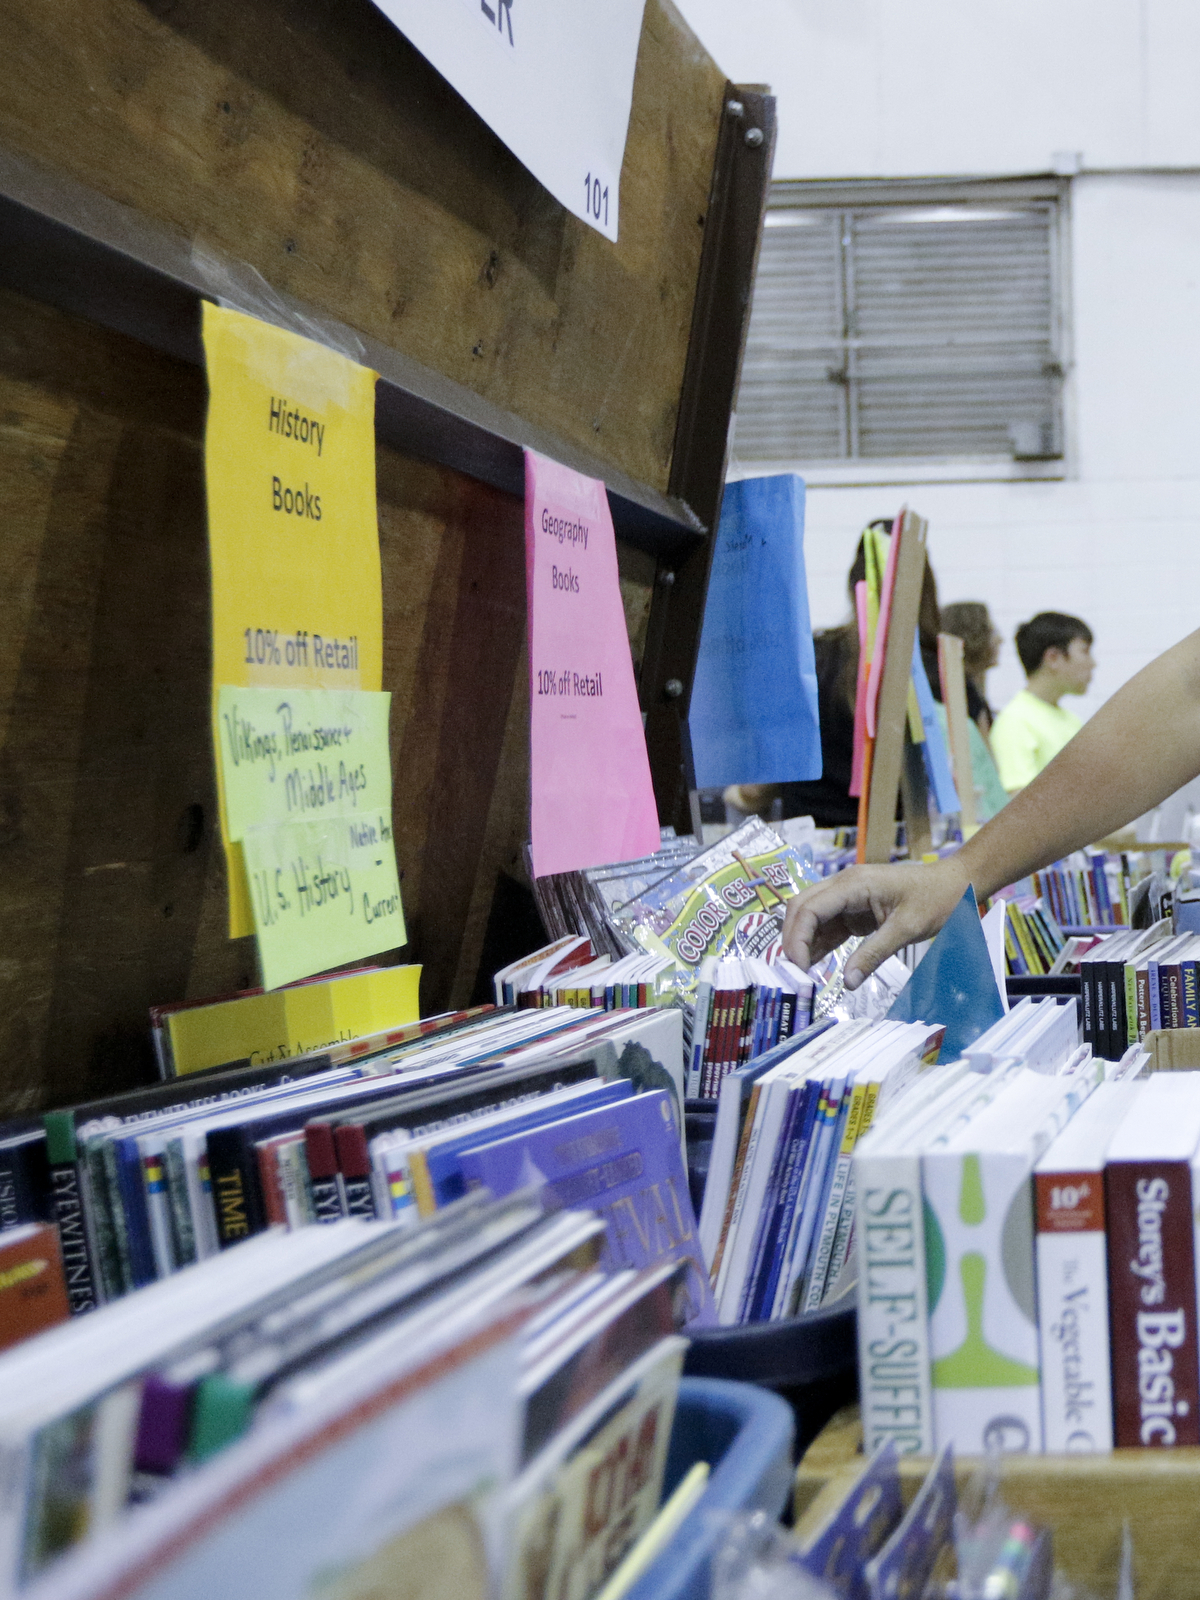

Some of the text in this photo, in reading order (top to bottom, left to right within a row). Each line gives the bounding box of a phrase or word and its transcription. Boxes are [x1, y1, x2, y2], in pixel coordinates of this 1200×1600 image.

[584, 172, 608, 226] 101
[268, 396, 325, 457] History
[272, 475, 322, 521] Books
[541, 508, 589, 550] Geography
[552, 565, 580, 593] Books
[245, 628, 358, 671] 10% off Retail
[538, 670, 603, 696] 10% off Retail
[338, 760, 367, 807] Ages
[292, 855, 354, 917] History
[677, 901, 731, 962] COLOR
[1169, 975, 1179, 1028] Celebrations
[1184, 968, 1197, 1011] FAMILY
[779, 1002, 791, 1036] GREAT
[833, 1162, 848, 1190] LIFE
[217, 1168, 249, 1239] TIME
[829, 1193, 842, 1207] IN
[814, 1211, 838, 1283] PLYMOUTH
[1051, 1286, 1097, 1426] Vegetable
[1137, 1306, 1190, 1446] Basic
